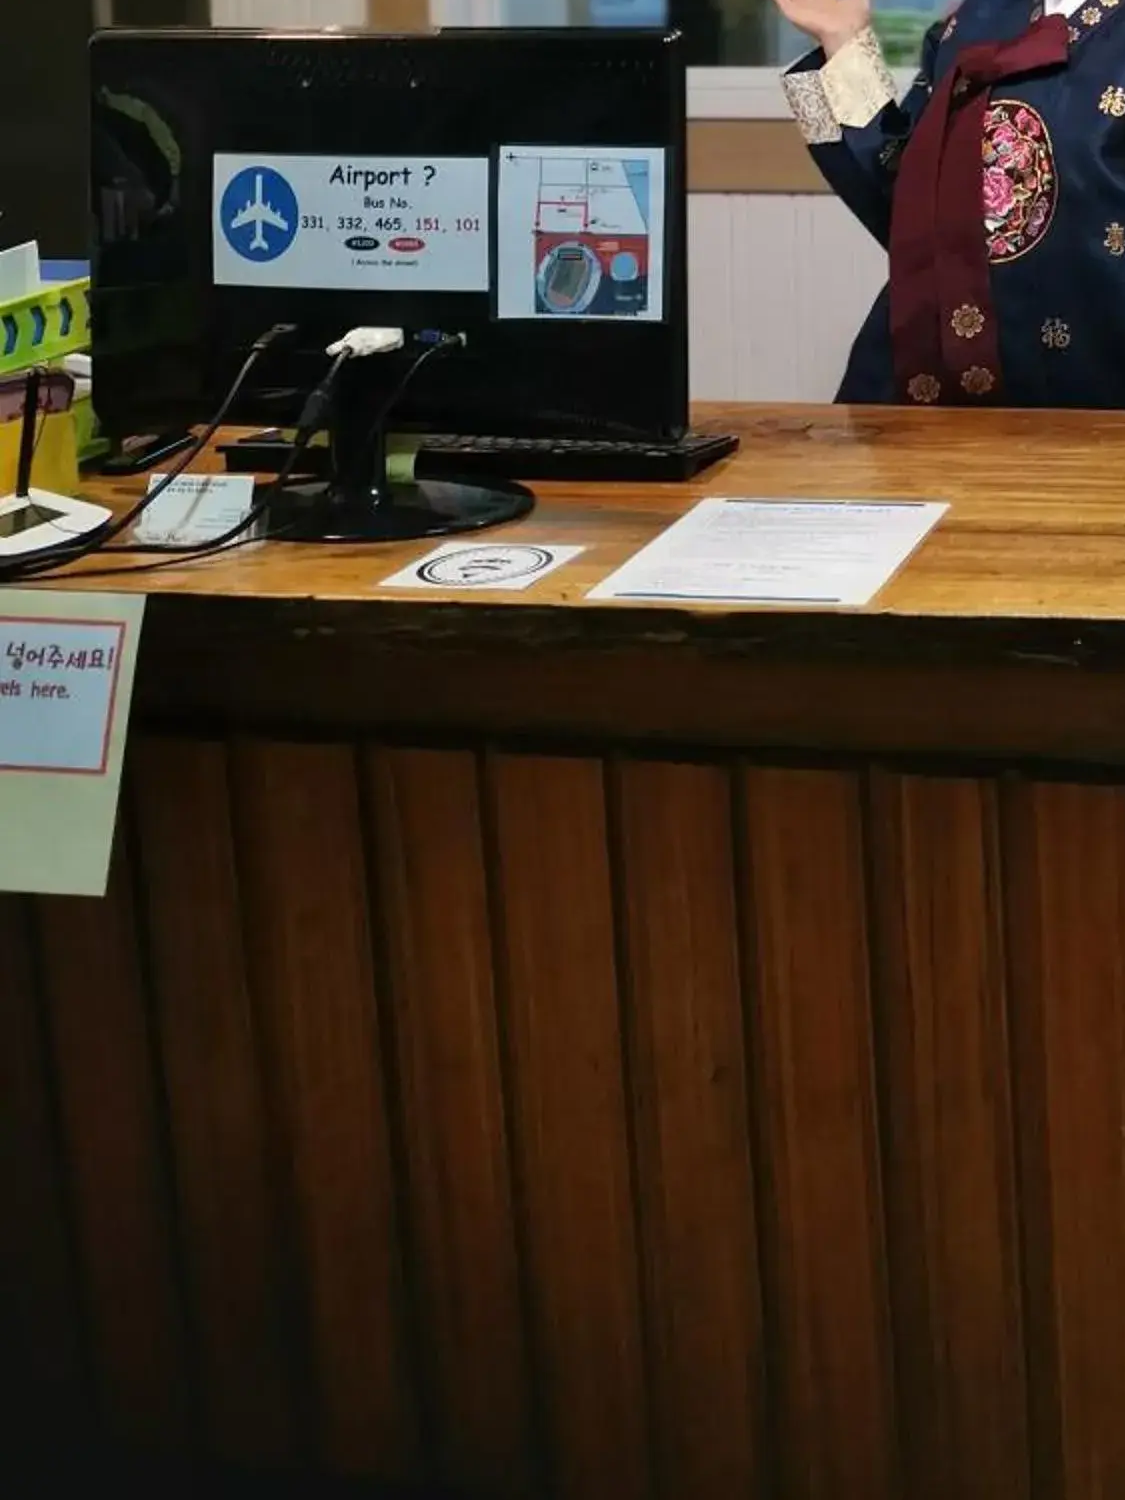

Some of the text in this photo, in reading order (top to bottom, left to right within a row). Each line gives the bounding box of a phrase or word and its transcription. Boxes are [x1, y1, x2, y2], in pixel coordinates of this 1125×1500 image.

[329, 164, 436, 191] Airport ?
[363, 197, 385, 209] Bus
[456, 218, 480, 232] 101
[31, 682, 70, 699] here.
